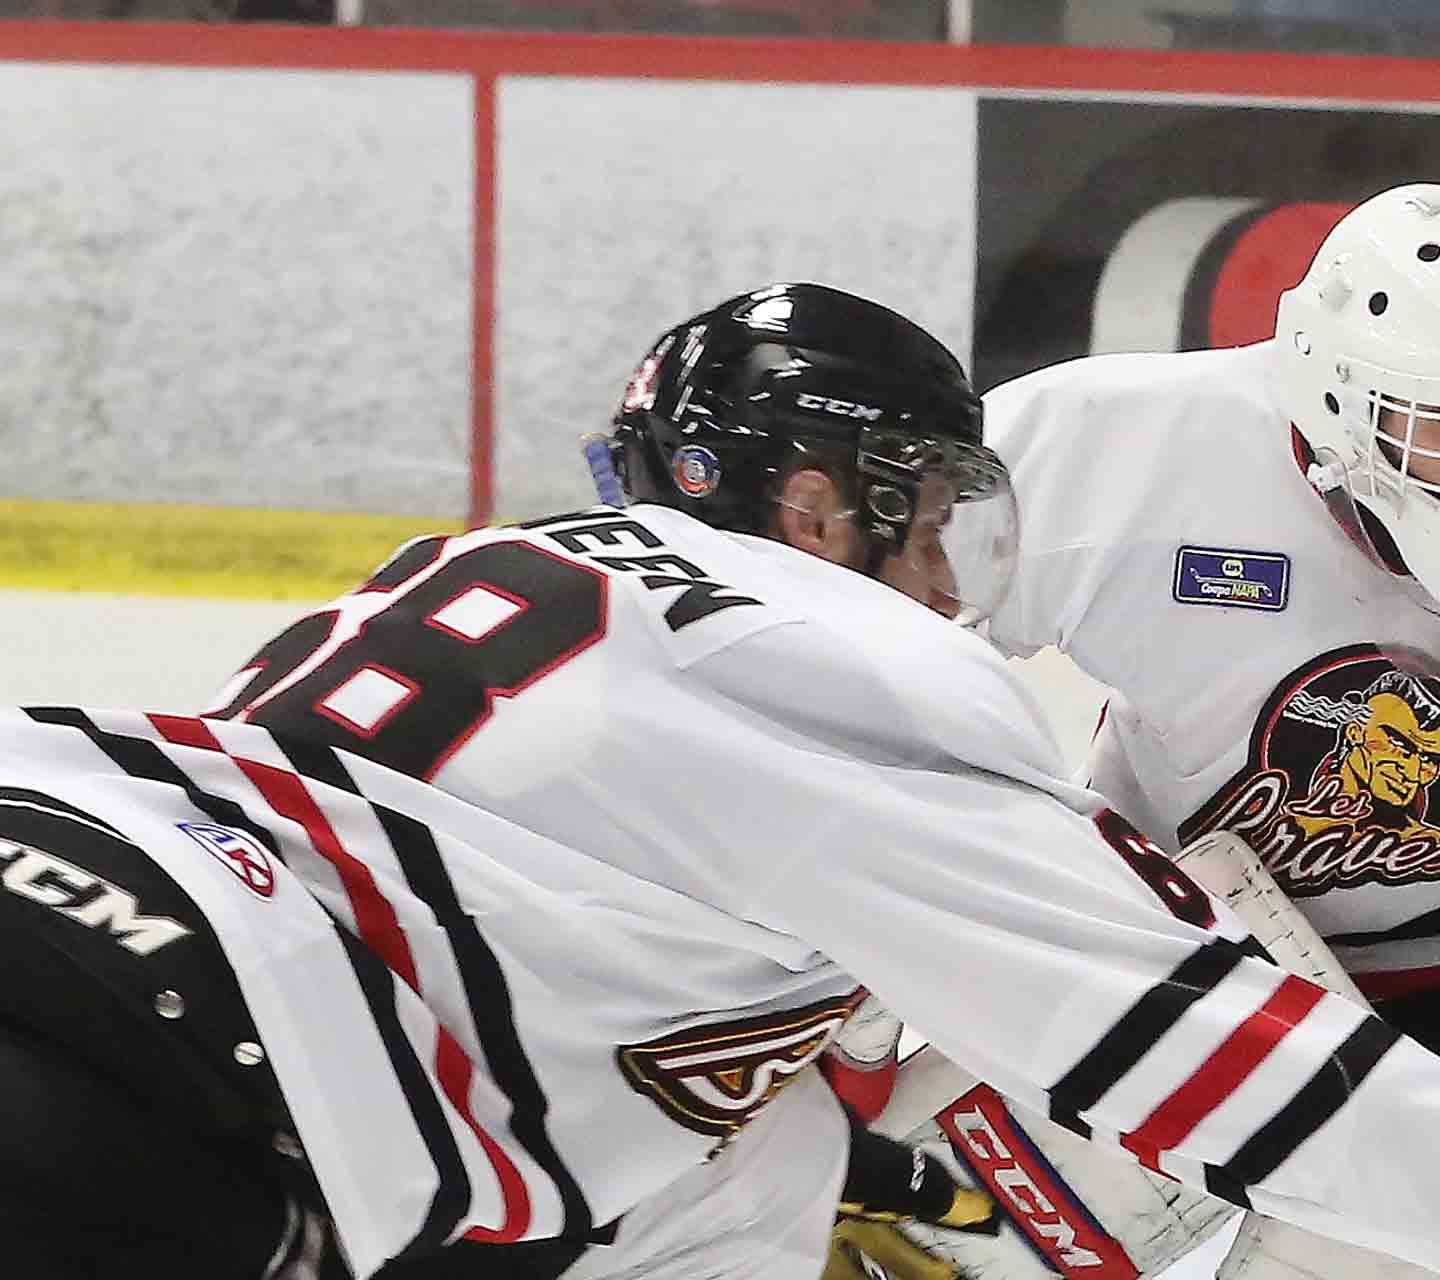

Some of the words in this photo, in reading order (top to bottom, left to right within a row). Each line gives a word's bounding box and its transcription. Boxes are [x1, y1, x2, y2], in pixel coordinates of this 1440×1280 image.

[795, 392, 884, 421] CCM
[1286, 776, 1373, 818] Les
[954, 1104, 1103, 1273] CCM
